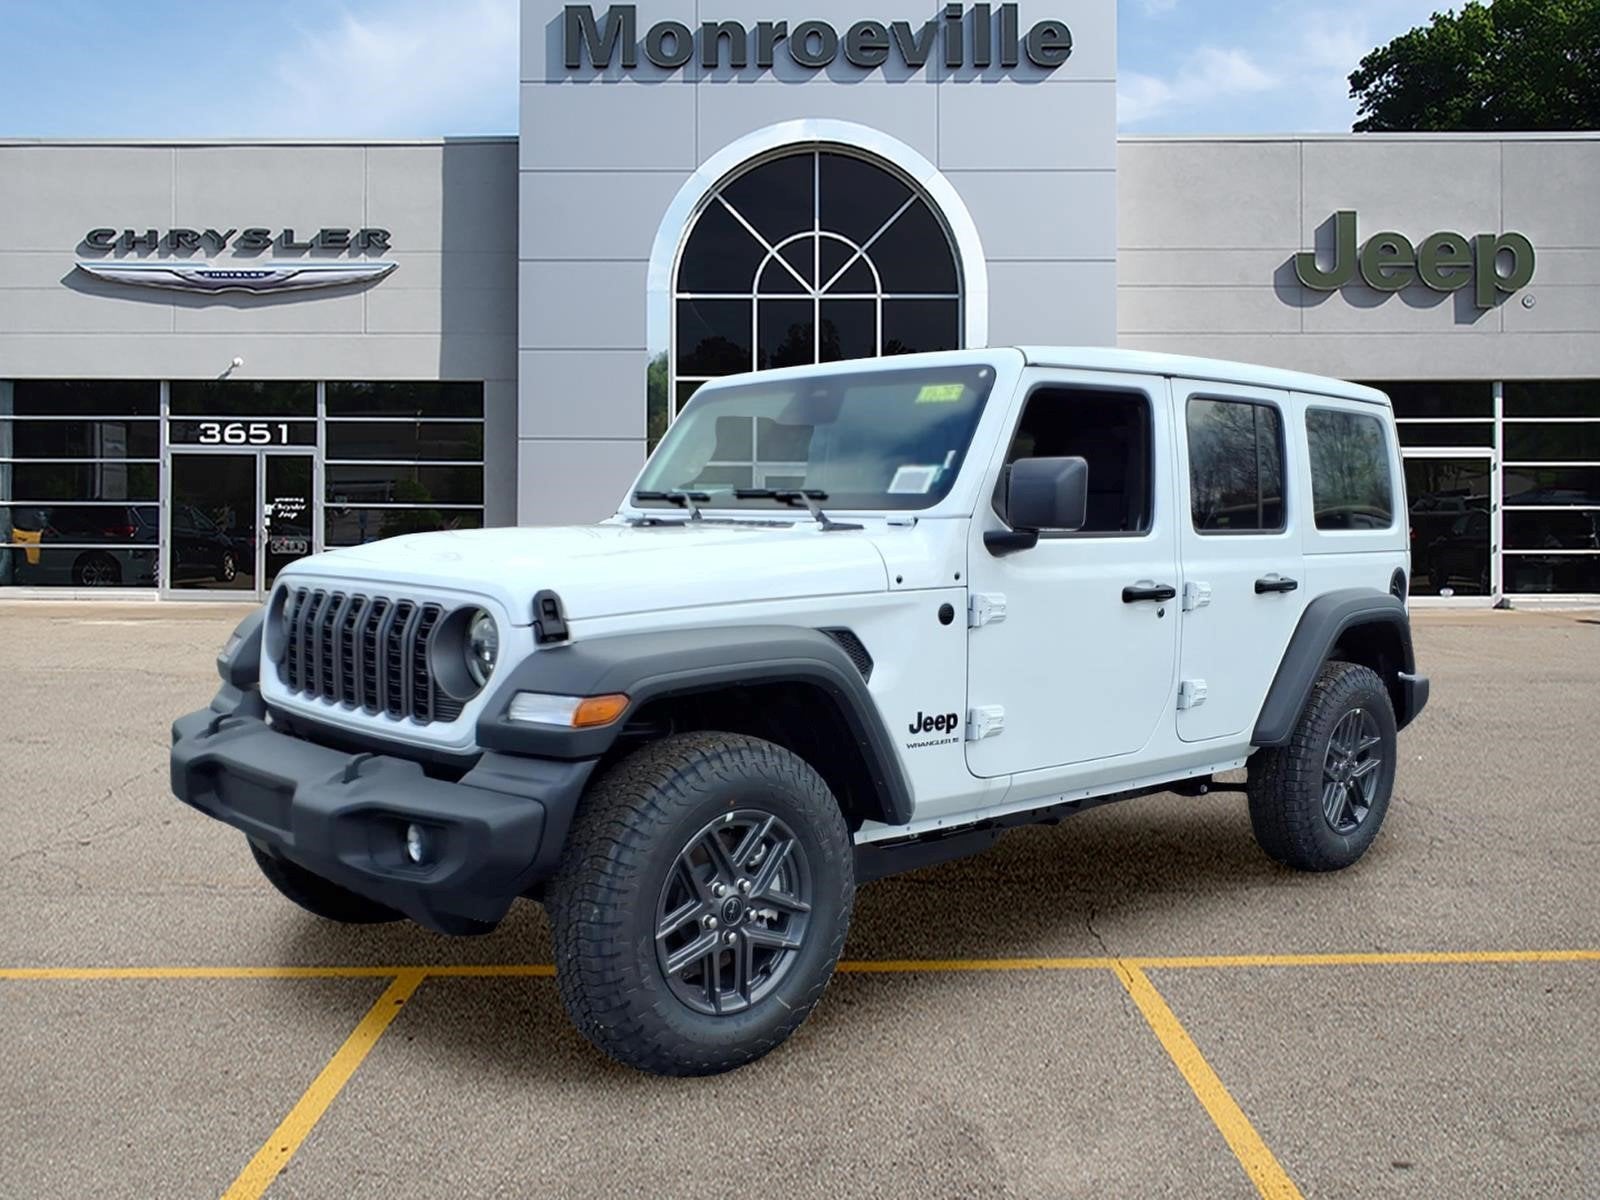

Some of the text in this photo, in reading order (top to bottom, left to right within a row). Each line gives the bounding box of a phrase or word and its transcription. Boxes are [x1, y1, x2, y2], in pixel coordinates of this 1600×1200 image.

[563, 3, 1073, 70] Monroeville
[85, 228, 392, 250] CHRYSLER
[1296, 211, 1535, 308] Jeep
[199, 422, 288, 444] 3651
[908, 711, 959, 734] Jeep
[906, 738, 951, 749] WRANGLER
